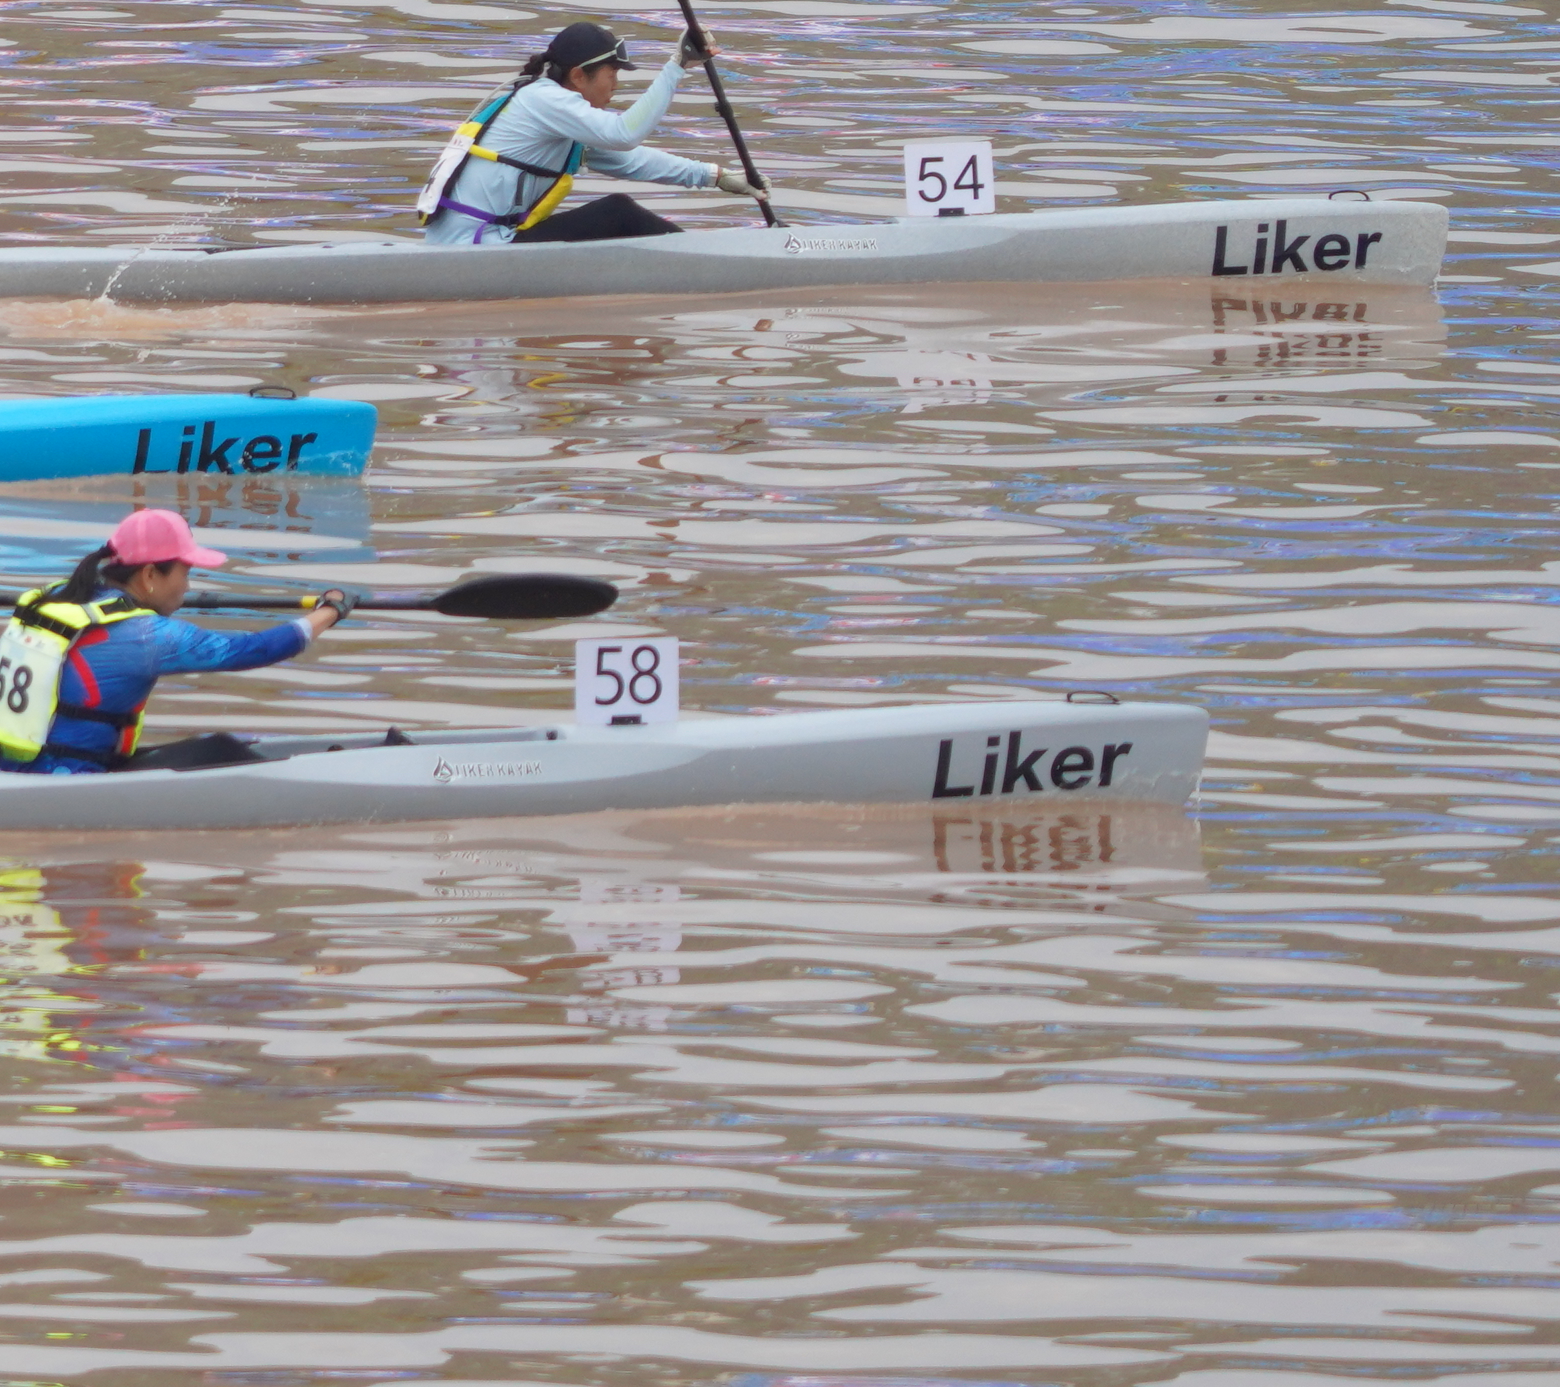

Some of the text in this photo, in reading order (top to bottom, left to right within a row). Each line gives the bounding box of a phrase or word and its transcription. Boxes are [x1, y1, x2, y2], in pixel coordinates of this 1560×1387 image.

[917, 153, 985, 203] 54
[1211, 219, 1383, 276] Liker
[135, 420, 319, 477] Liker
[594, 644, 663, 705] 58
[931, 731, 1132, 799] Liker
